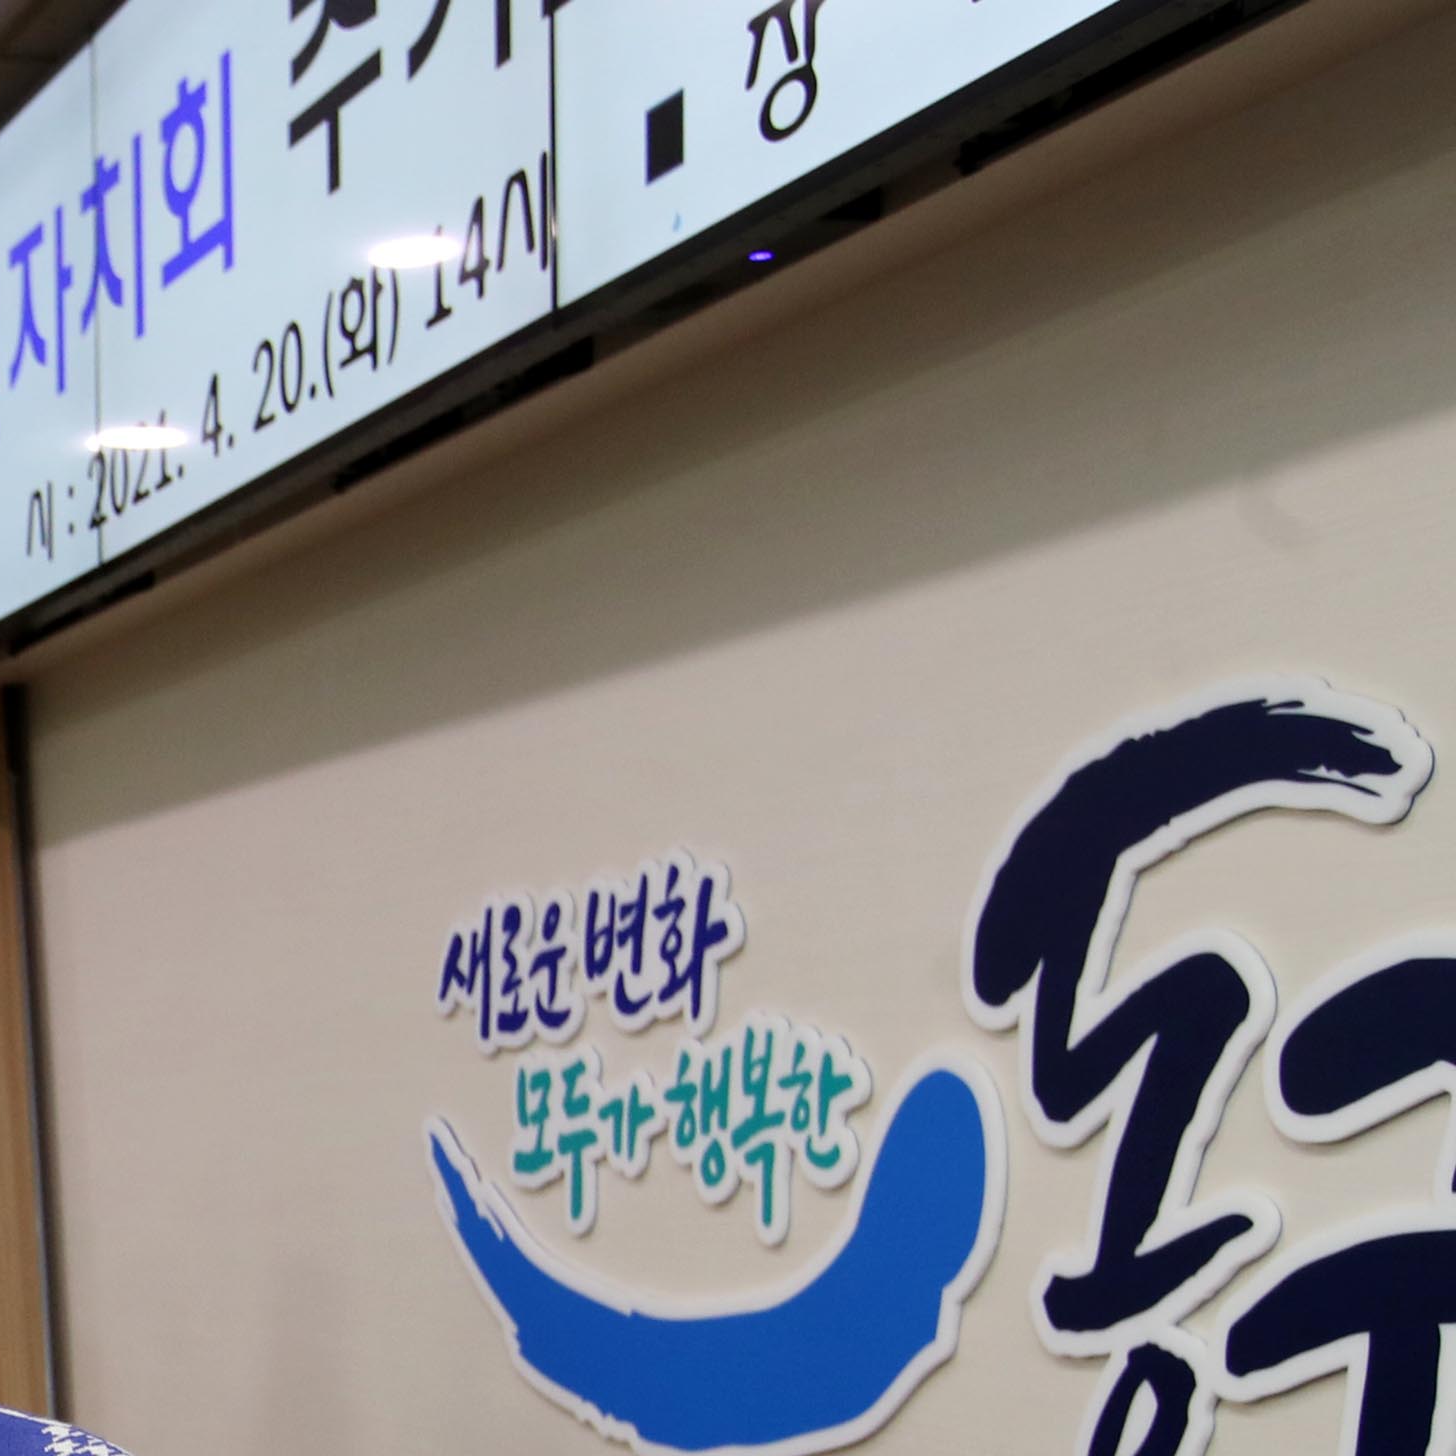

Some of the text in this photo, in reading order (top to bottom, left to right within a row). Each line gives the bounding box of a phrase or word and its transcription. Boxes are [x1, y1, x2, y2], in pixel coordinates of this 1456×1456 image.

[438, 862, 730, 1040] 새로운 변화
[514, 1028, 854, 1228] 모두가 행복한
